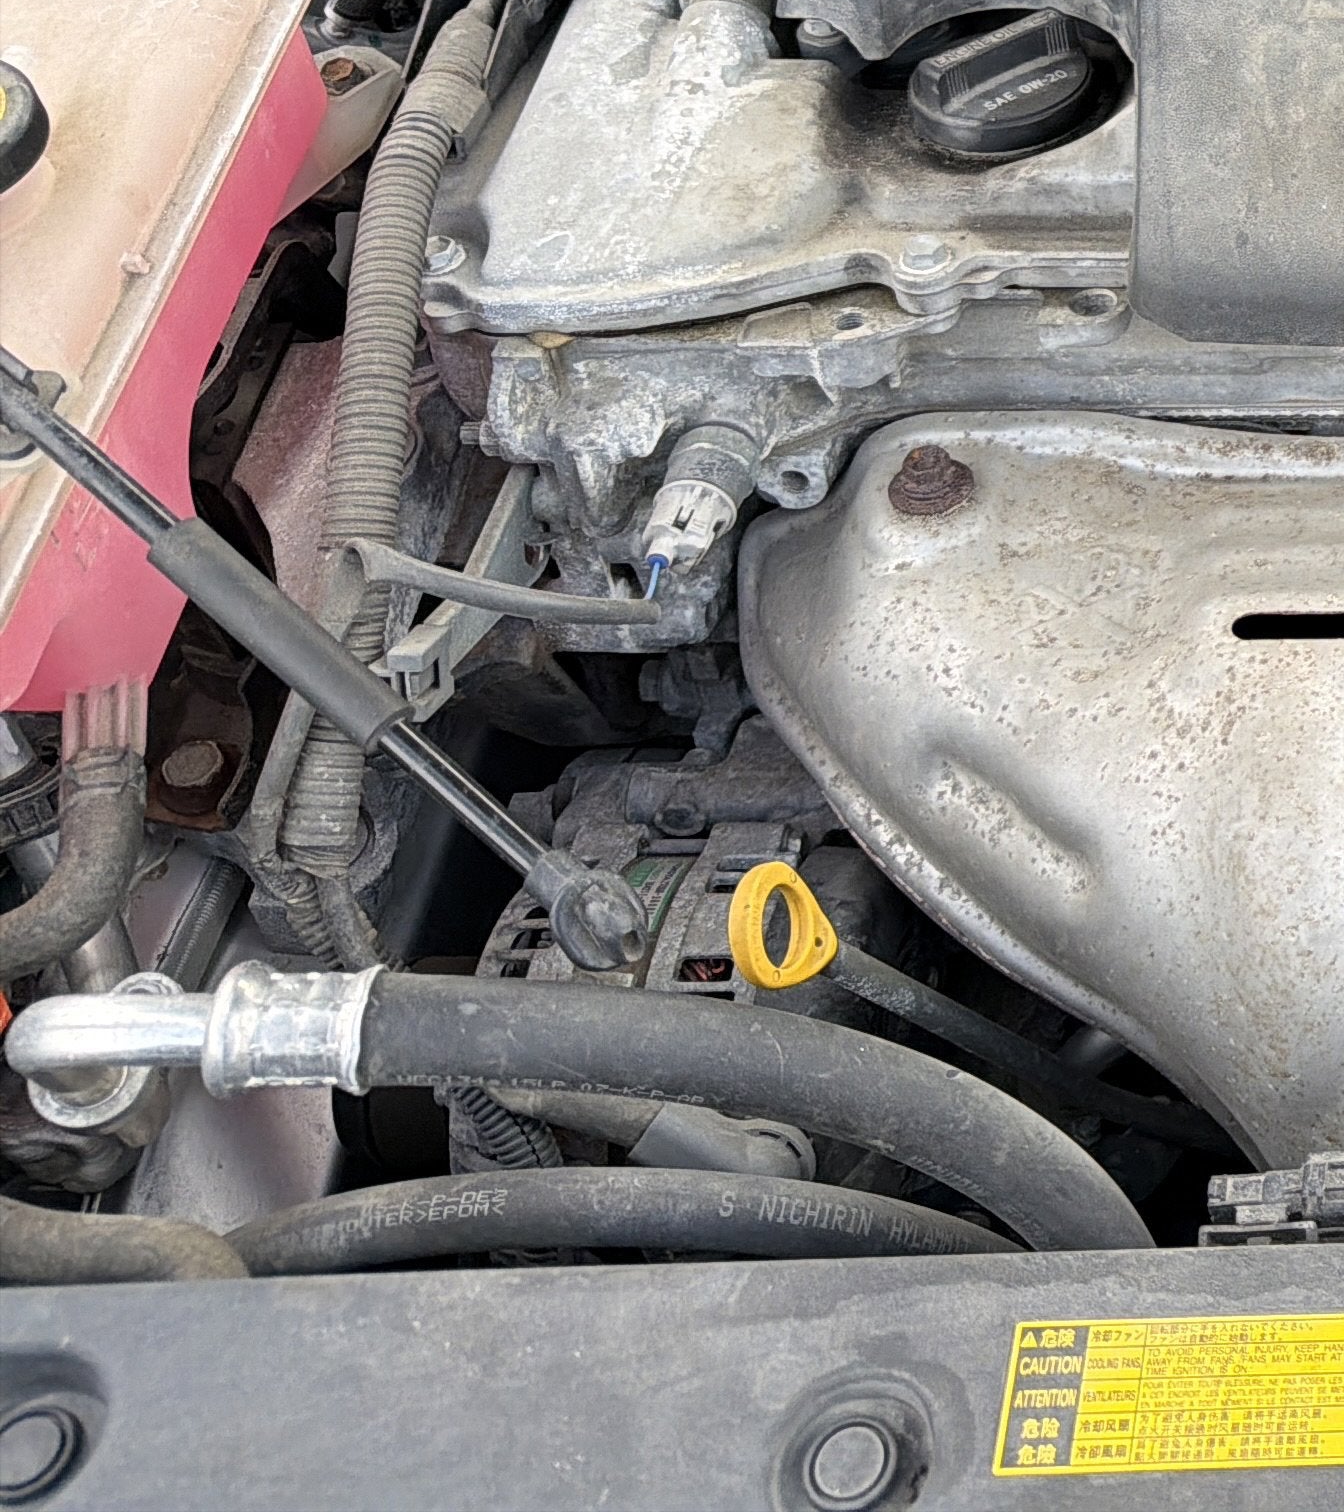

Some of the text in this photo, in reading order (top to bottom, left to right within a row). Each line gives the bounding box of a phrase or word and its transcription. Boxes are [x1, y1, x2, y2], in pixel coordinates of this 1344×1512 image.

[934, 26, 1021, 67] ENGINE OIL
[983, 70, 1068, 111] SAE 0W-20
[718, 1190, 873, 1237] S NICHIRIN
[1039, 1328, 1076, 1348] 危険
[1091, 1328, 1146, 1344] 冷却ファン
[1148, 1348, 1162, 1357] TO
[1165, 1347, 1194, 1357] AVOID
[1198, 1346, 1250, 1356] PERSONAL
[1294, 1344, 1320, 1354] KEEP
[1018, 1355, 1082, 1376] CAUTION
[1086, 1357, 1142, 1370] COOLING FANS
[1146, 1358, 1174, 1368] AWAY
[1178, 1357, 1205, 1367] FROM
[1241, 1355, 1268, 1365] FANS
[1271, 1354, 1291, 1364] MAY
[1295, 1353, 1329, 1364] START
[1330, 1353, 1344, 1363] AT
[1144, 1366, 1169, 1376] TIME
[1172, 1365, 1217, 1376] IGNITION
[1220, 1365, 1230, 1375] IS
[1014, 1388, 1077, 1408] ATTENTION
[1082, 1390, 1137, 1403] VENTILATEURS
[1021, 1418, 1061, 1437] 危险
[1078, 1418, 1131, 1434] 冷却风扇
